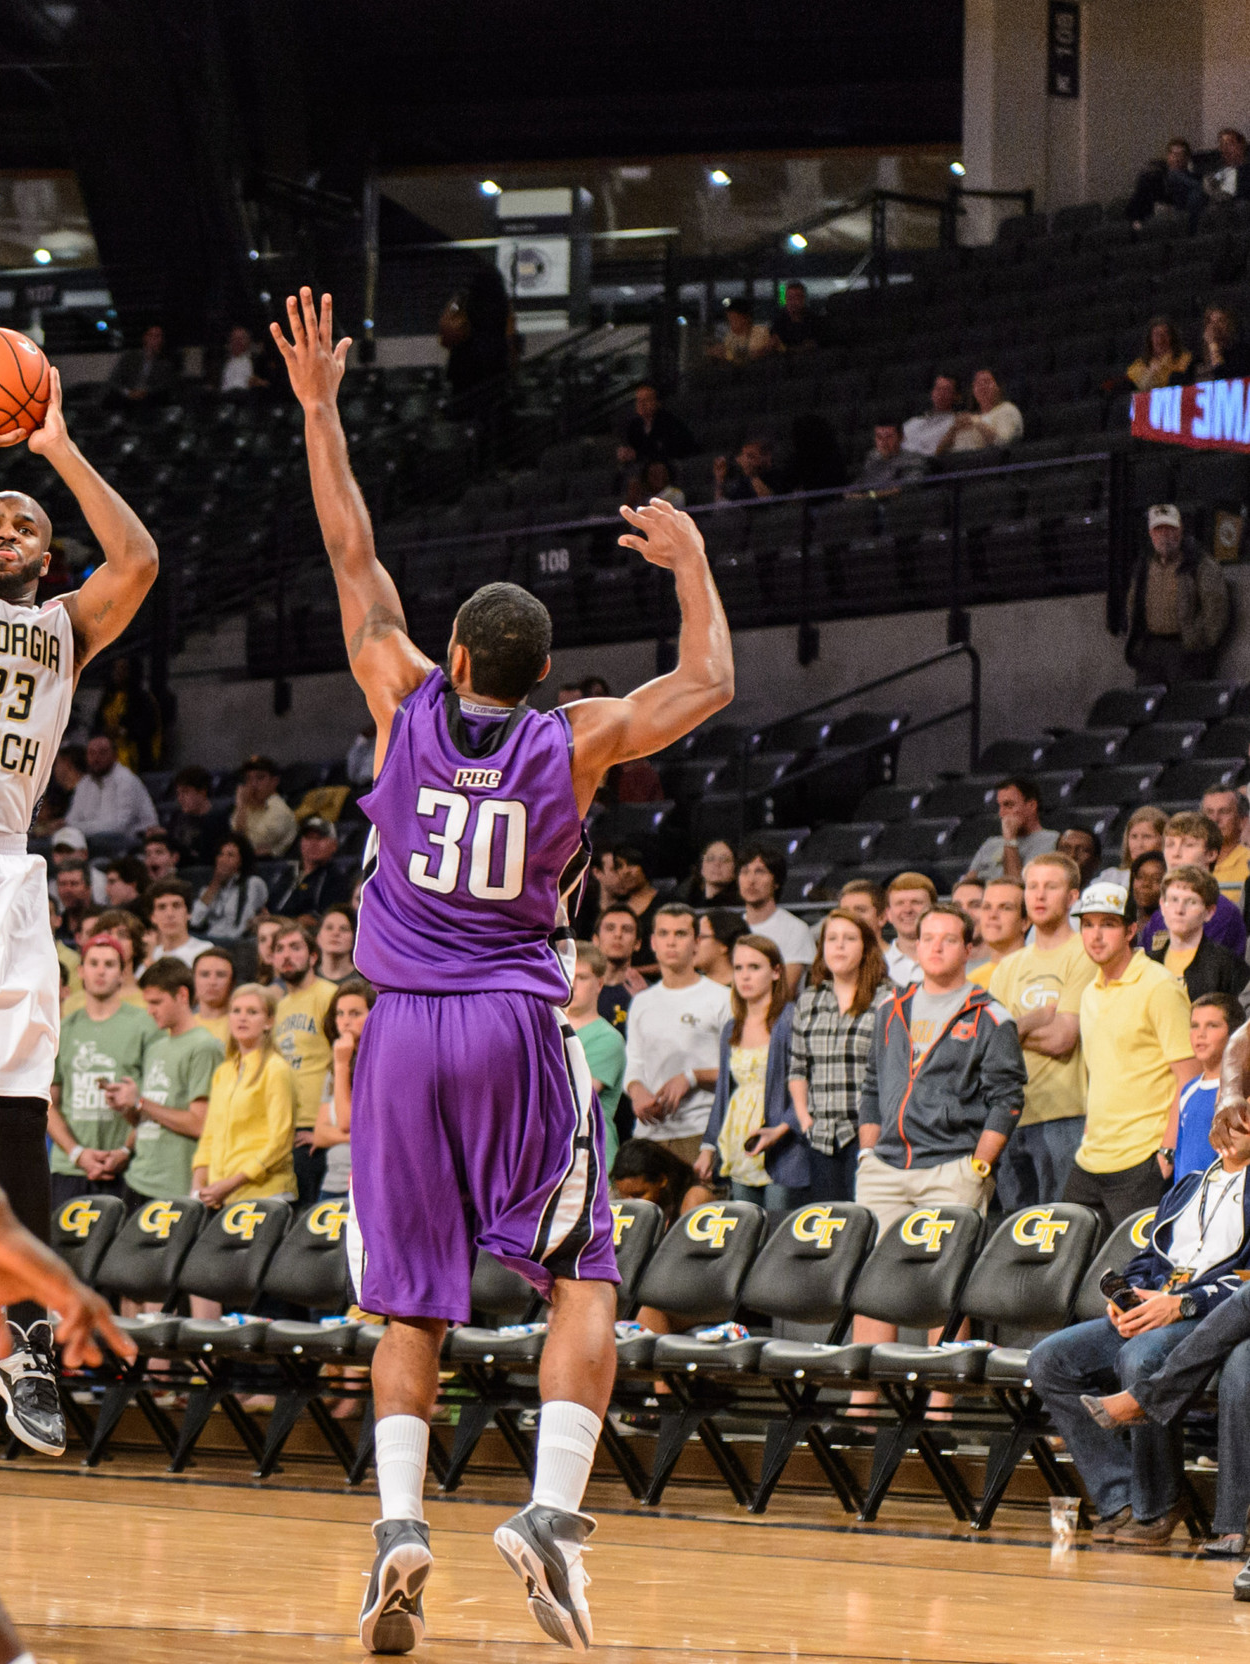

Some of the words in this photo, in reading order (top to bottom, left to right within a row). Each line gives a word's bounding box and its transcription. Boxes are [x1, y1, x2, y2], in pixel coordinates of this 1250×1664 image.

[453, 769, 502, 788] PBC
[408, 786, 528, 901] 30
[1020, 983, 1060, 1010] GT
[59, 1200, 101, 1238] GT
[138, 1201, 182, 1239] GT
[222, 1202, 266, 1240] GT
[307, 1202, 348, 1241] GT
[609, 1204, 635, 1246] T
[686, 1205, 738, 1248] GT
[792, 1206, 847, 1249] GT
[901, 1208, 955, 1252] GT
[1012, 1208, 1069, 1253] GT
